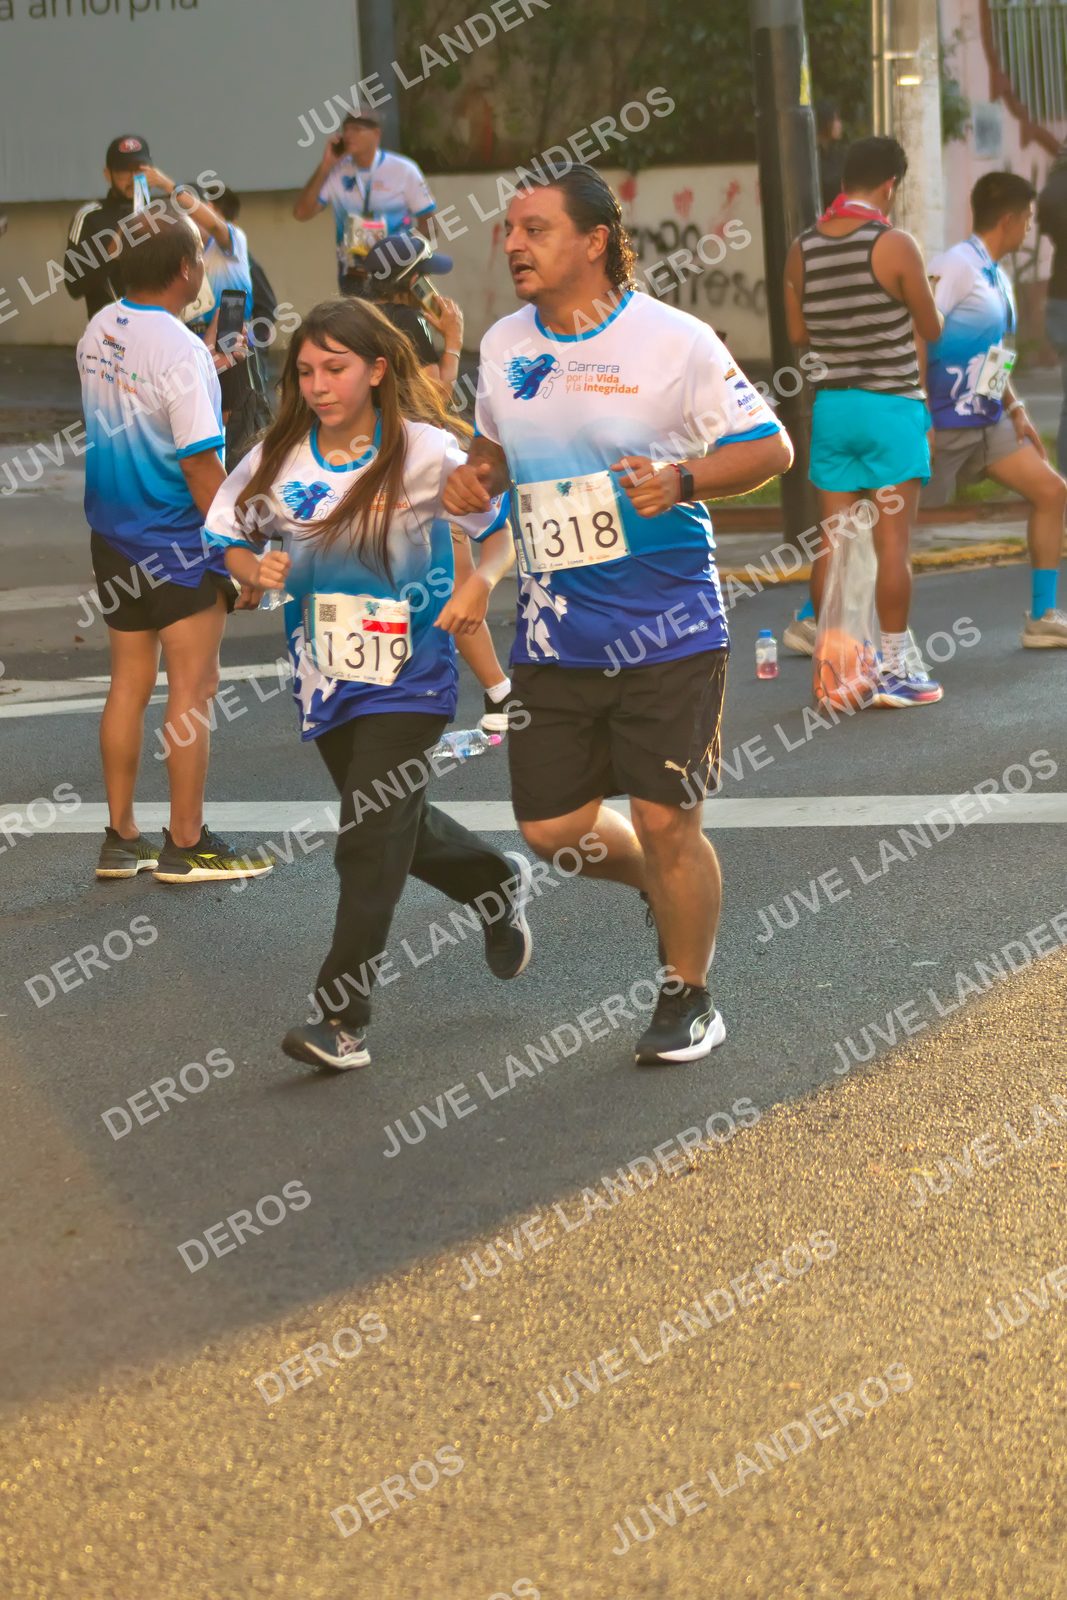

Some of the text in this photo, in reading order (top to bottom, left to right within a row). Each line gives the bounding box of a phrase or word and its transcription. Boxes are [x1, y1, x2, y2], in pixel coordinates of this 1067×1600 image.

[567, 360, 621, 374] Carrera
[565, 374, 583, 386] por
[596, 374, 620, 384] Vida
[583, 383, 640, 395] Integridad
[525, 510, 618, 560] 1318
[323, 631, 409, 674] 1319
